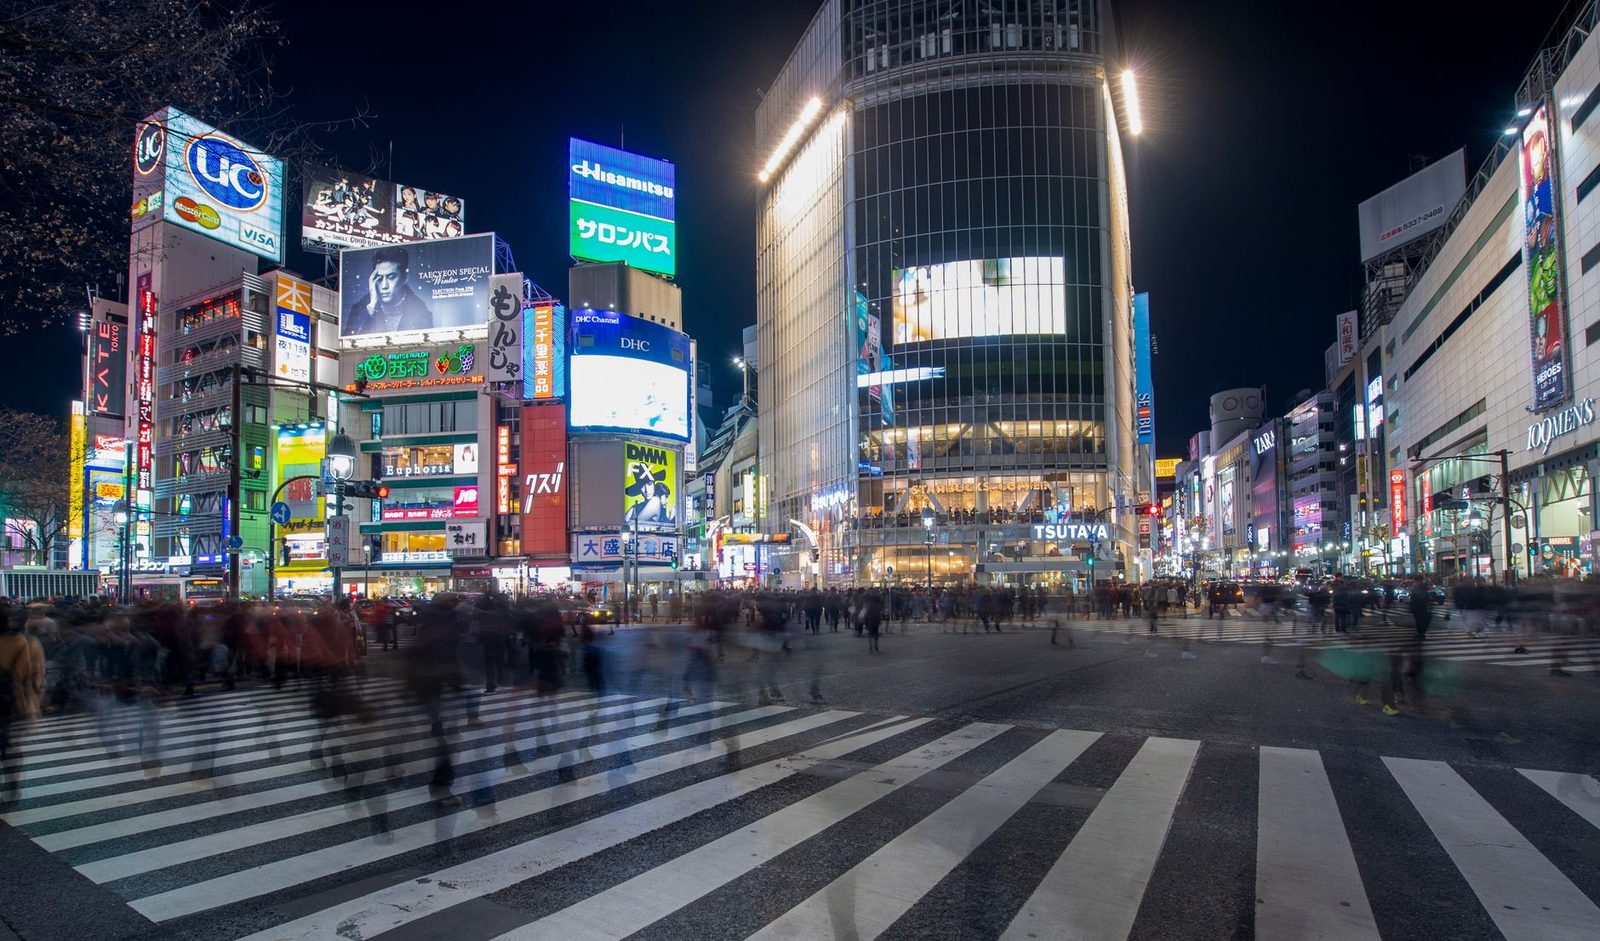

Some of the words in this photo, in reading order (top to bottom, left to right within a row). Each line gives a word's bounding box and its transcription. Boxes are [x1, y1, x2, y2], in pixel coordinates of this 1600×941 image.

[196, 145, 260, 199] UC
[572, 160, 673, 198] Hisamitsu
[243, 228, 275, 249] VISA
[576, 218, 671, 255] サロンパス
[419, 269, 457, 280] TAECYEON
[459, 266, 489, 275] SPECIAL
[277, 281, 311, 312] 本
[575, 315, 591, 323] DHC
[592, 316, 619, 324] Channel
[490, 285, 521, 377] もんじゃ
[535, 309, 549, 393] 三千里薬品
[621, 337, 650, 352] DHC
[388, 359, 429, 379] 西村
[1536, 362, 1562, 385] HEROES
[1137, 392, 1151, 436] SEIBU
[1254, 430, 1275, 454] ZARA
[627, 444, 668, 466] DMM
[386, 465, 451, 477] Euphoria
[627, 462, 655, 481] FX
[456, 489, 477, 505] JTB
[911, 482, 989, 495] STARBUCKS
[1034, 525, 1108, 539] TSUTAYA
[1549, 537, 1572, 545] MARVEL
[583, 539, 675, 556] 大盛堂書店
